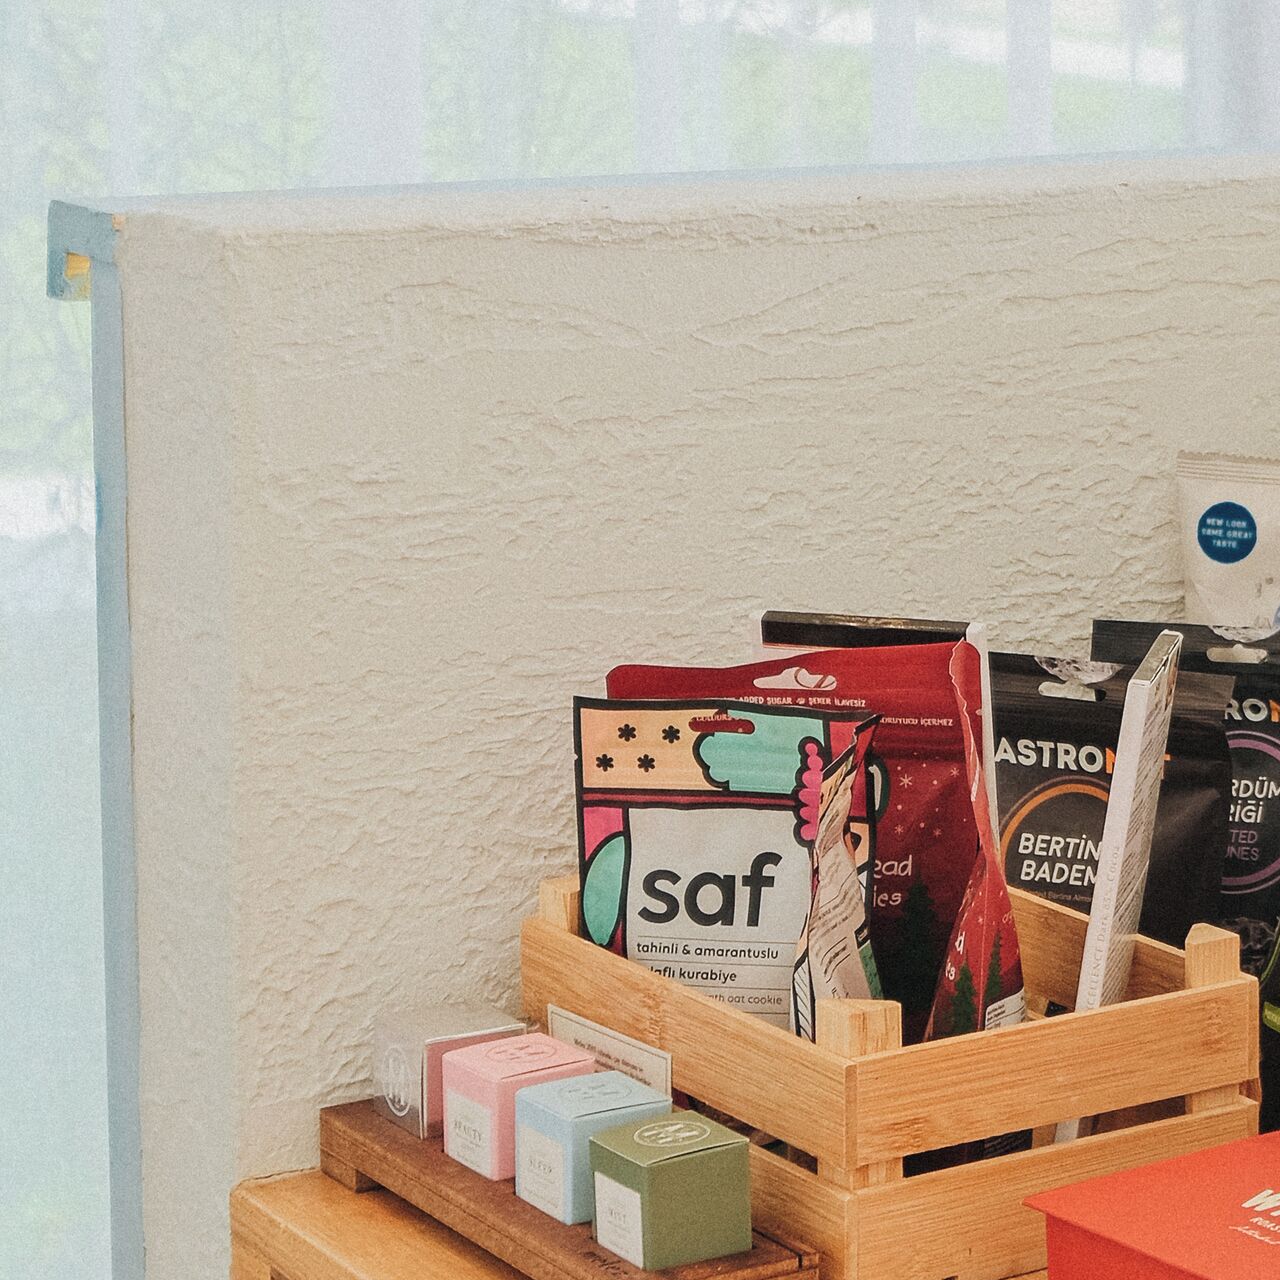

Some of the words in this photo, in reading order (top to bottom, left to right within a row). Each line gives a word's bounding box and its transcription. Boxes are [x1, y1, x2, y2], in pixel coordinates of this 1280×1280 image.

[1018, 832, 1103, 861] BERTİN
[637, 851, 783, 928] saf
[637, 941, 679, 955] tahinli
[681, 944, 691, 955] &
[694, 947, 779, 960] amarantuslu
[679, 967, 737, 985] kurabiye
[727, 995, 745, 1005] oat
[747, 994, 783, 1006] cookie
